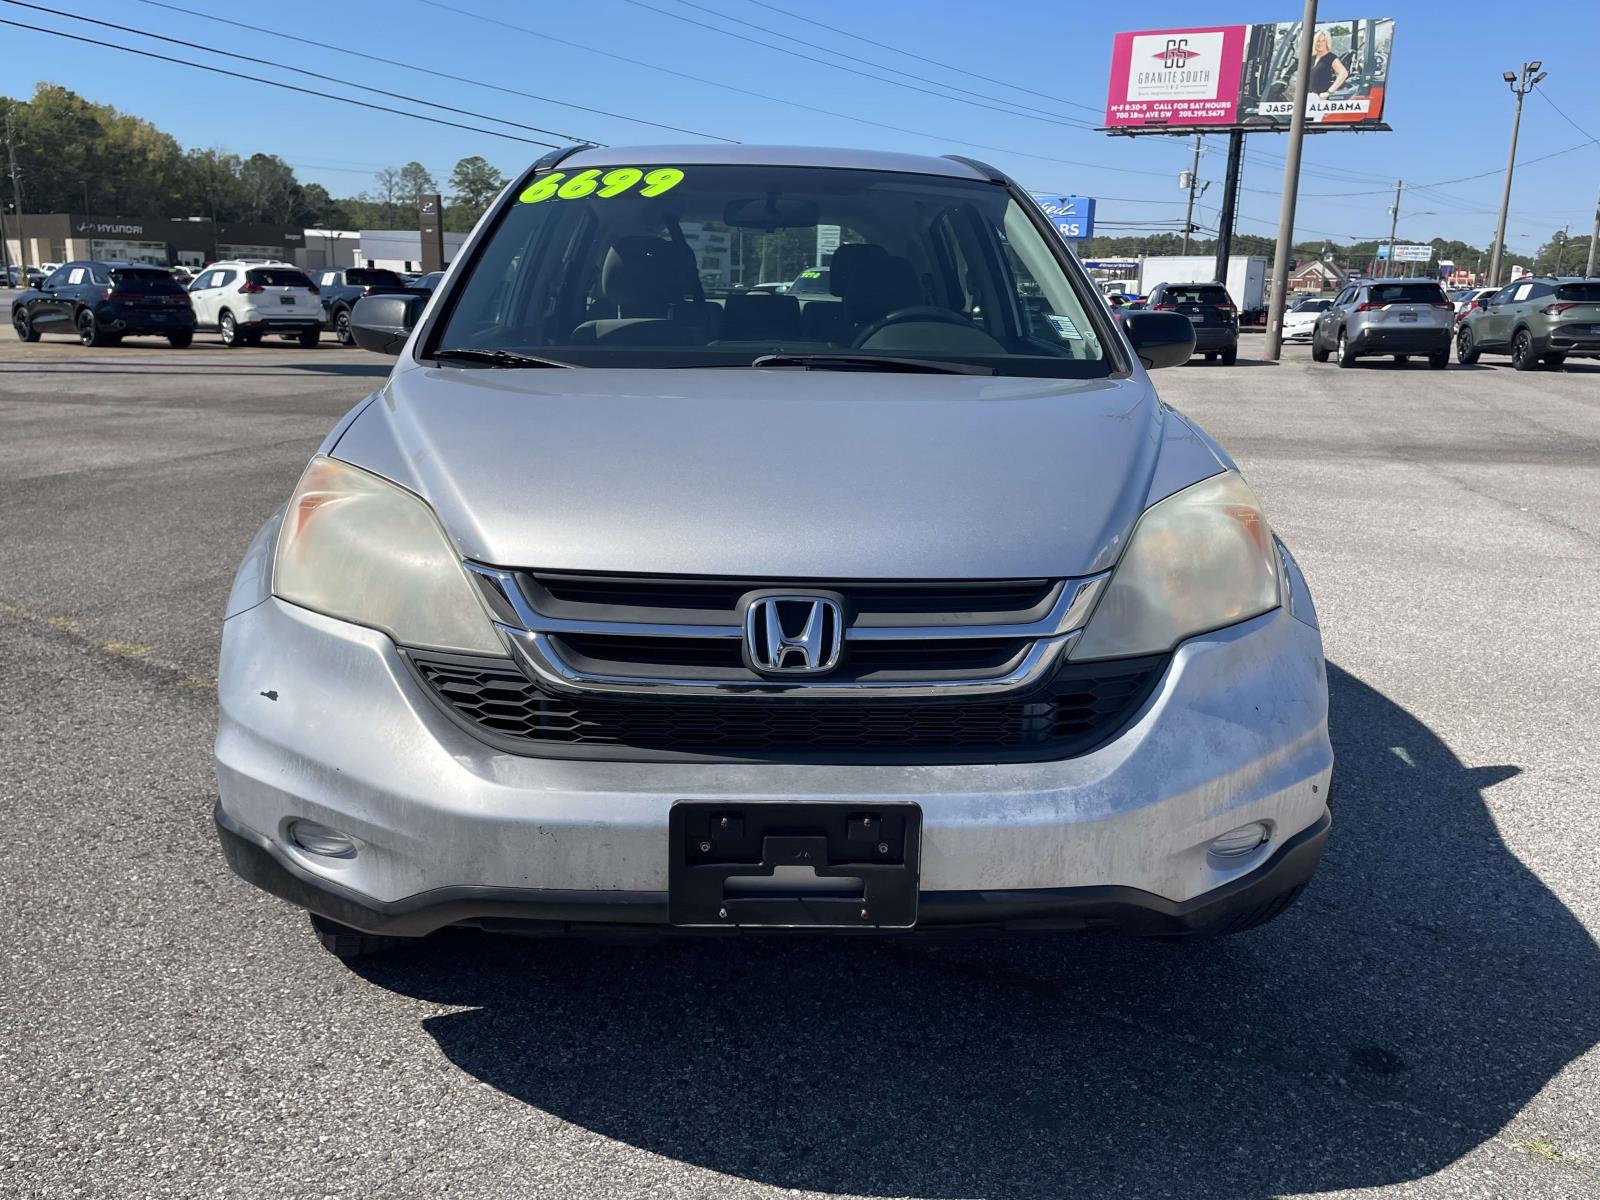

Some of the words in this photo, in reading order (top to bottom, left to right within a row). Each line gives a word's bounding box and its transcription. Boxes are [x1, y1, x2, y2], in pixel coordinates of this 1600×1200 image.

[1138, 71, 1178, 85] GRANITE
[1180, 70, 1211, 83] SOUTH
[1266, 104, 1294, 113] JASP
[1309, 103, 1362, 112] ALABAMA
[519, 168, 685, 204] 6699
[97, 223, 143, 234] HYUNDAI
[1060, 224, 1080, 236] RS
